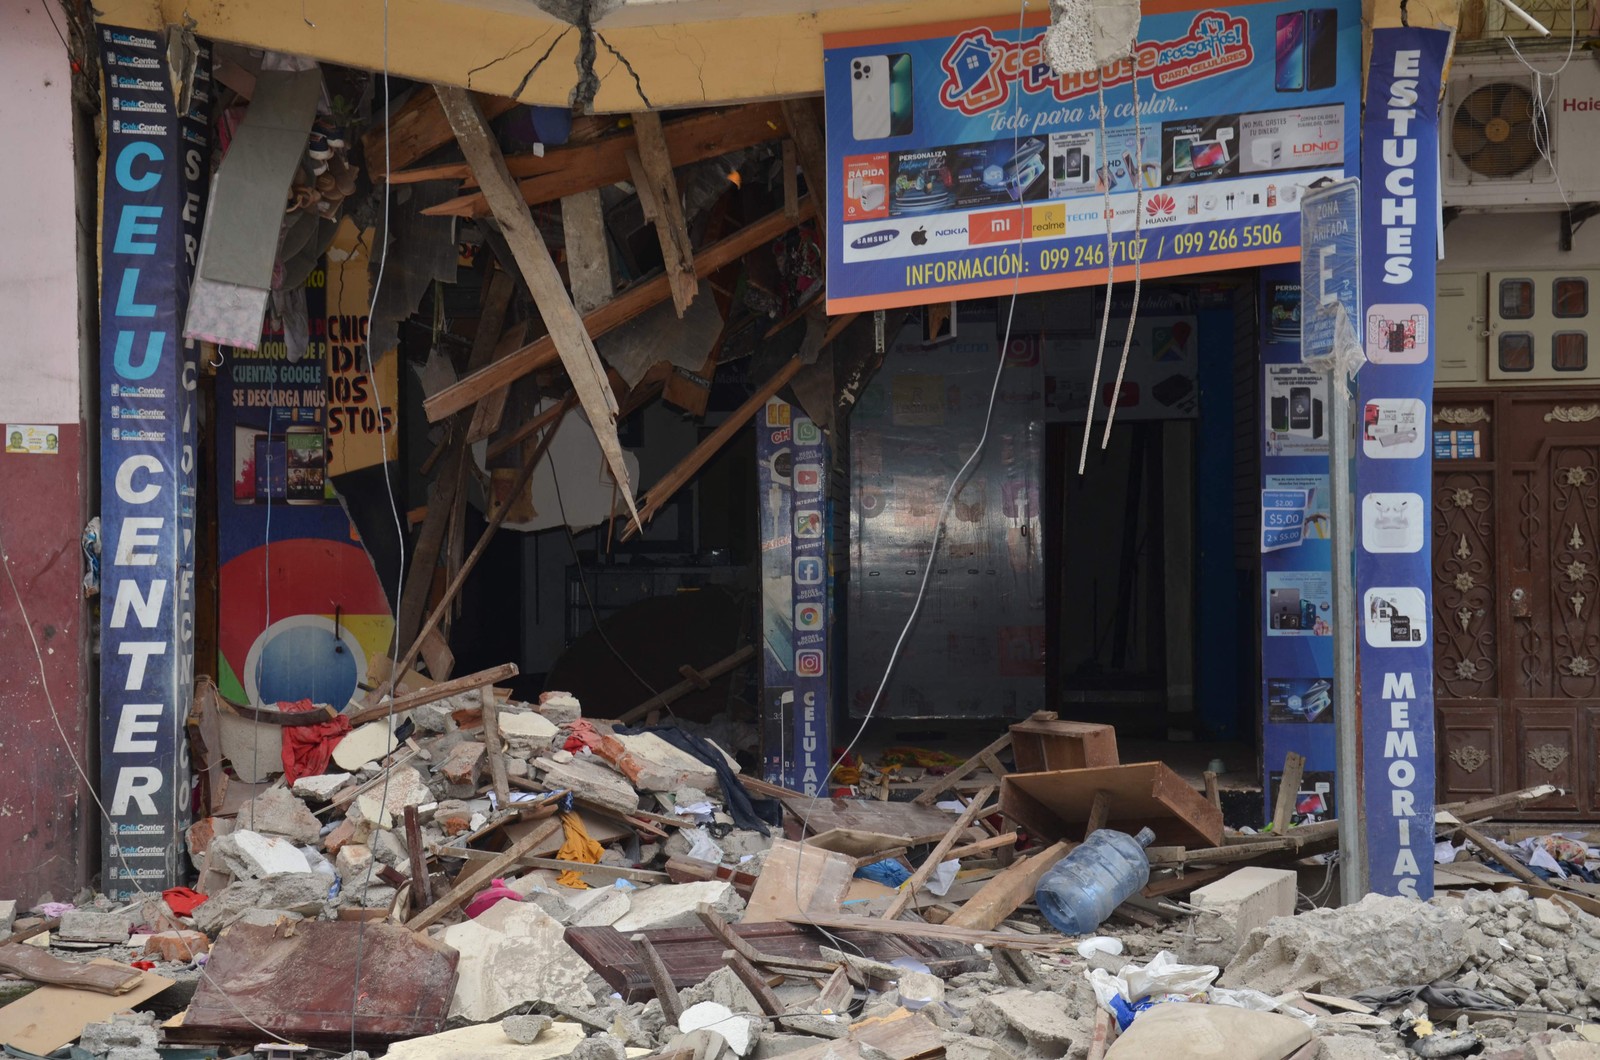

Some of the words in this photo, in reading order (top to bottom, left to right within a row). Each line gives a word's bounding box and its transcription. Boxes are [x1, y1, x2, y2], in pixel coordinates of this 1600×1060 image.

[1160, 68, 1189, 83] PARA
[1191, 51, 1246, 73] CELULARES
[1032, 107, 1083, 134] para
[1293, 141, 1339, 154] LDNIO
[899, 150, 947, 161] PERSONALIZA
[1381, 50, 1421, 285] ESTUCHES
[1067, 211, 1099, 222] TECNO
[1317, 200, 1339, 219] ZONA
[1032, 220, 1065, 231] realme
[1145, 215, 1177, 225] HUAWEI
[856, 233, 894, 245] SAMSUNG
[935, 227, 968, 237] NOKIA
[113, 141, 165, 380] CELU
[906, 248, 1030, 286] INFORMACIÓN:
[1040, 248, 1070, 271] 099
[1075, 246, 1104, 267] 246
[1111, 238, 1148, 262] 7107
[1173, 232, 1205, 255] 099
[1209, 227, 1237, 250] 266
[1242, 223, 1282, 247] 5506
[1319, 244, 1337, 306] E
[1103, 339, 1140, 348] NOIA
[232, 365, 278, 384] CUENTAS
[280, 365, 321, 384] GOOGLE
[232, 389, 245, 407] SE
[248, 389, 300, 407] DESCARGA
[1269, 513, 1299, 526] $5.00
[796, 541, 822, 550] INTERNET
[1267, 534, 1272, 542] 2
[110, 454, 167, 816] CENTER
[1382, 672, 1421, 899] MEMORIAS
